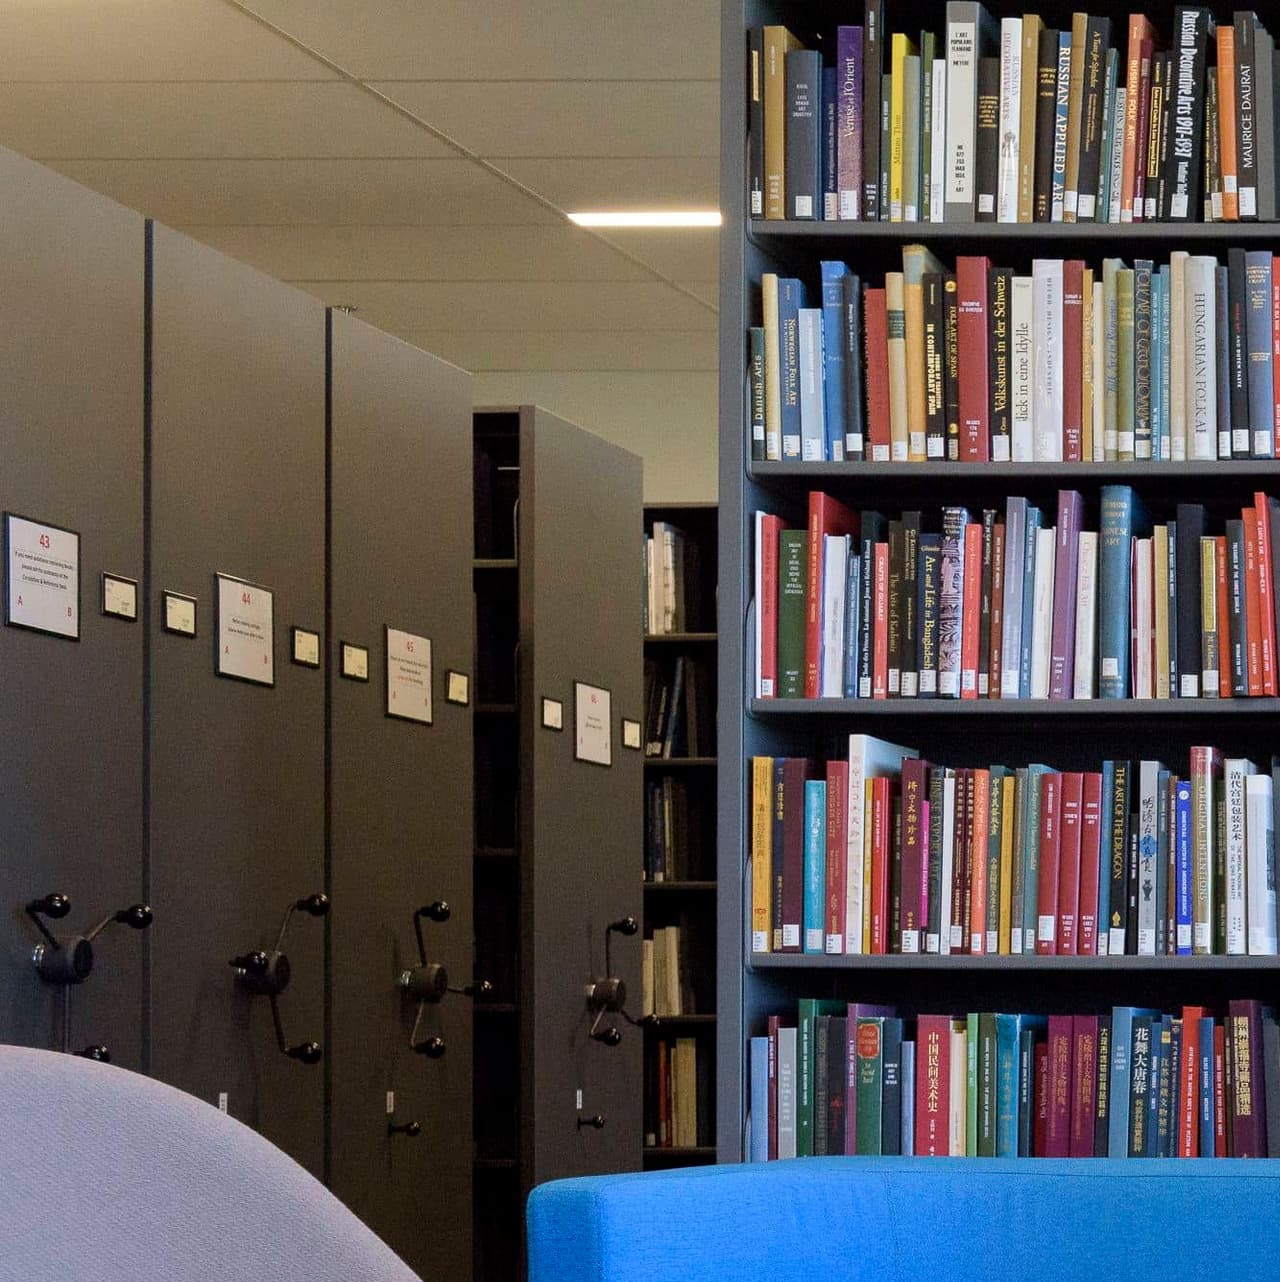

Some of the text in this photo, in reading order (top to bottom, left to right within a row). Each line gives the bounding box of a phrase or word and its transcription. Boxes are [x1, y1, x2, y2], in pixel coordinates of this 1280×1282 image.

[1174, 11, 1198, 157] Russian Decorative Arts 1917-1937
[1054, 47, 1071, 202] RUSSIAN APPLIED AR
[1240, 64, 1253, 167] MAURICE DAURAT
[995, 276, 1005, 317] Schweiz
[928, 324, 935, 332] IN
[997, 343, 1005, 352] in
[1194, 294, 1206, 376] HUNGARIAN
[928, 396, 936, 415] SPAIN
[995, 356, 1005, 410] Volkskunst
[1196, 381, 1206, 416] FOLK
[38, 534, 50, 548] 43
[18, 596, 22, 606] A
[242, 592, 250, 606] 44
[923, 556, 934, 669] Art and Life in Bangladesh
[890, 621, 899, 652] Kashmir
[1114, 767, 1125, 879] THE ART OF THE DRAGON
[928, 1032, 939, 1112] 中国民间美术史
[1133, 1028, 1148, 1093] 花舞大唐春
